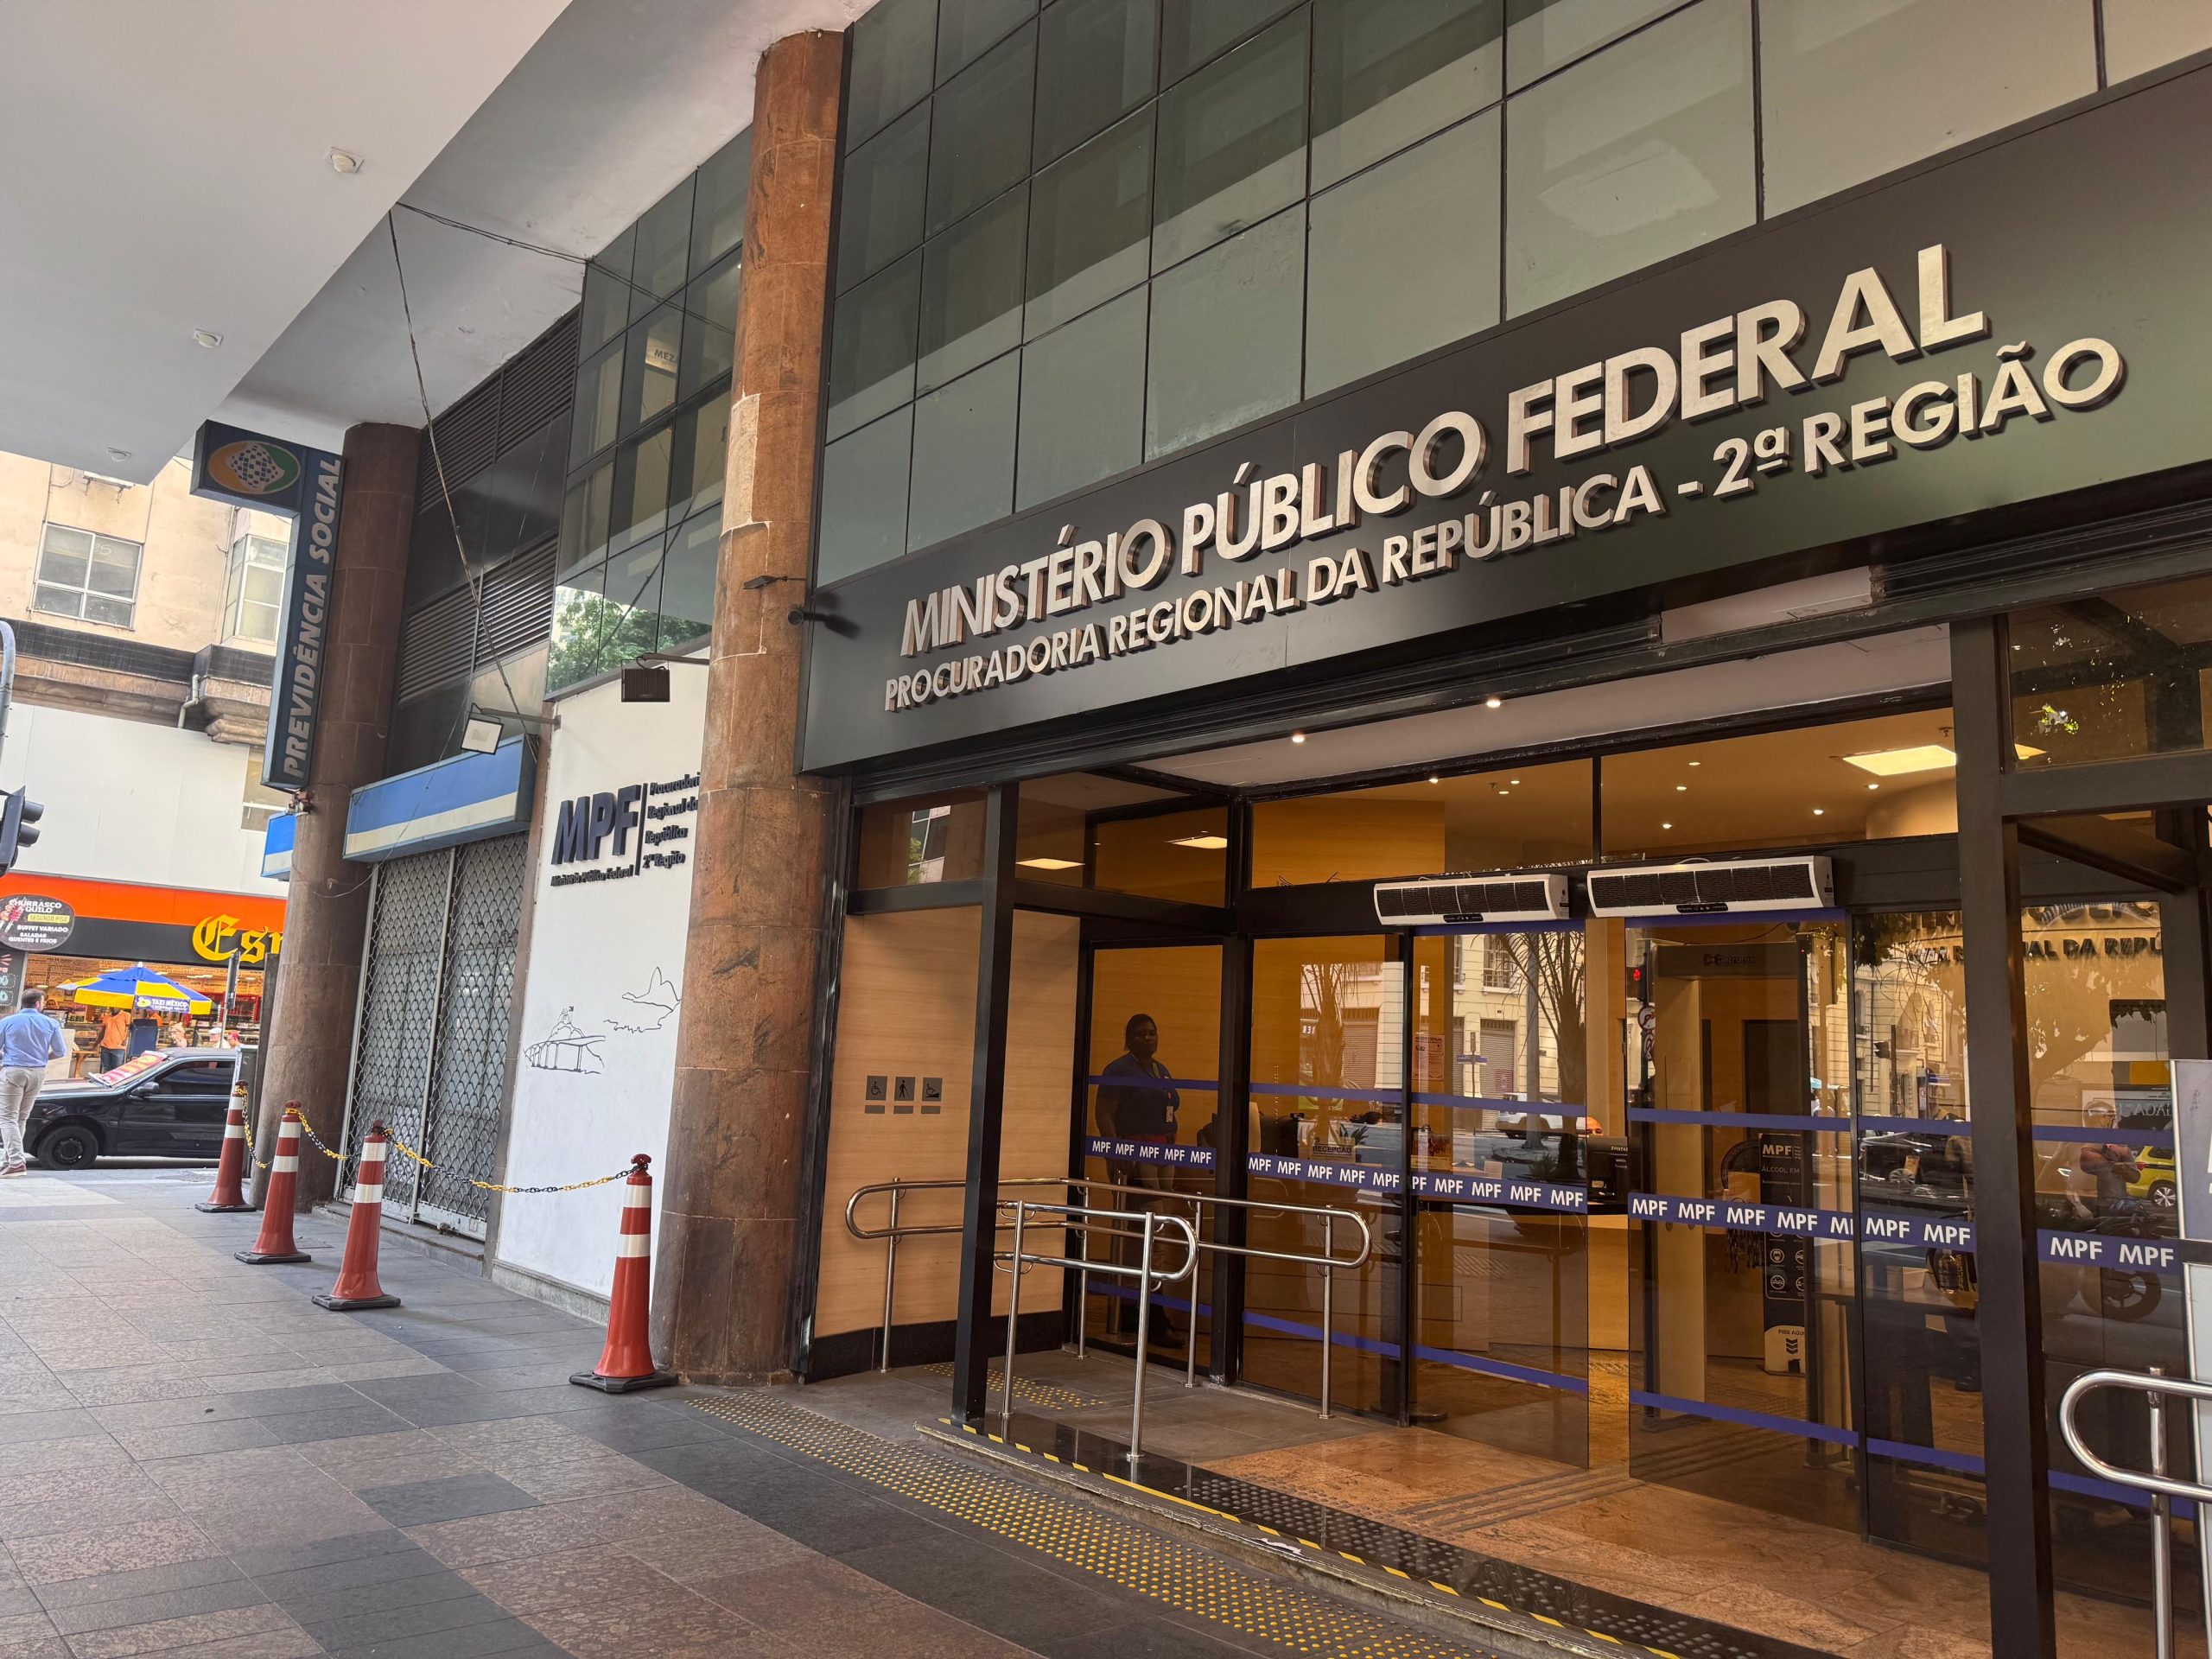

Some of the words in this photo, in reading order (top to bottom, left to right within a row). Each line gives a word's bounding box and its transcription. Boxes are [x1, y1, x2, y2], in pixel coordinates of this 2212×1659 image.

[900, 518, 1173, 658] MINISTÉRIO
[1181, 410, 1486, 577] PÚBLICO
[1507, 244, 1990, 476] FEDERAL
[885, 623, 1107, 712] PROCURADORIA
[1109, 568, 1302, 656] REGIONAL
[1306, 547, 1375, 604] DA
[1382, 465, 1665, 586] REPÚBLICA
[1677, 480, 1703, 497] -
[1713, 427, 1790, 499] 2ª
[1803, 338, 2123, 476] REGIÃO
[283, 574, 327, 777] PREVIDÊNCIA
[308, 459, 341, 564] SOCIAL
[650, 772, 700, 796] Procuradori
[551, 785, 641, 865] MPF
[9, 898, 62, 908] CHURRASCO
[1092, 1141, 1111, 1154] MPF
[1116, 1143, 1135, 1156] MPF
[1139, 1146, 1160, 1159] MPF
[1164, 1148, 1185, 1161] MPF
[1190, 1151, 1211, 1164] MPF
[1763, 1144, 1792, 1155] MPF
[1249, 1158, 1271, 1172] MPF
[1277, 1160, 1301, 1176] MPF
[1307, 1165, 1332, 1179] MPF
[1339, 1168, 1365, 1184] MPF
[1372, 1172, 1400, 1188] MPF
[1412, 1176, 1427, 1191] PF
[1434, 1179, 1464, 1194] MPF
[1471, 1181, 1502, 1198] MPF
[1510, 1185, 1541, 1202] MPF
[1550, 1190, 1583, 1207] MPF
[1632, 1198, 1668, 1217] MPF
[1678, 1202, 1715, 1221] MPF
[1726, 1207, 1765, 1226] MPF
[1777, 1212, 1818, 1231] MPF
[1866, 1217, 1910, 1238] MPF
[1923, 1224, 1971, 1245] MPF
[2050, 1236, 2102, 1260] MPF
[2119, 1244, 2174, 1268] MPF
